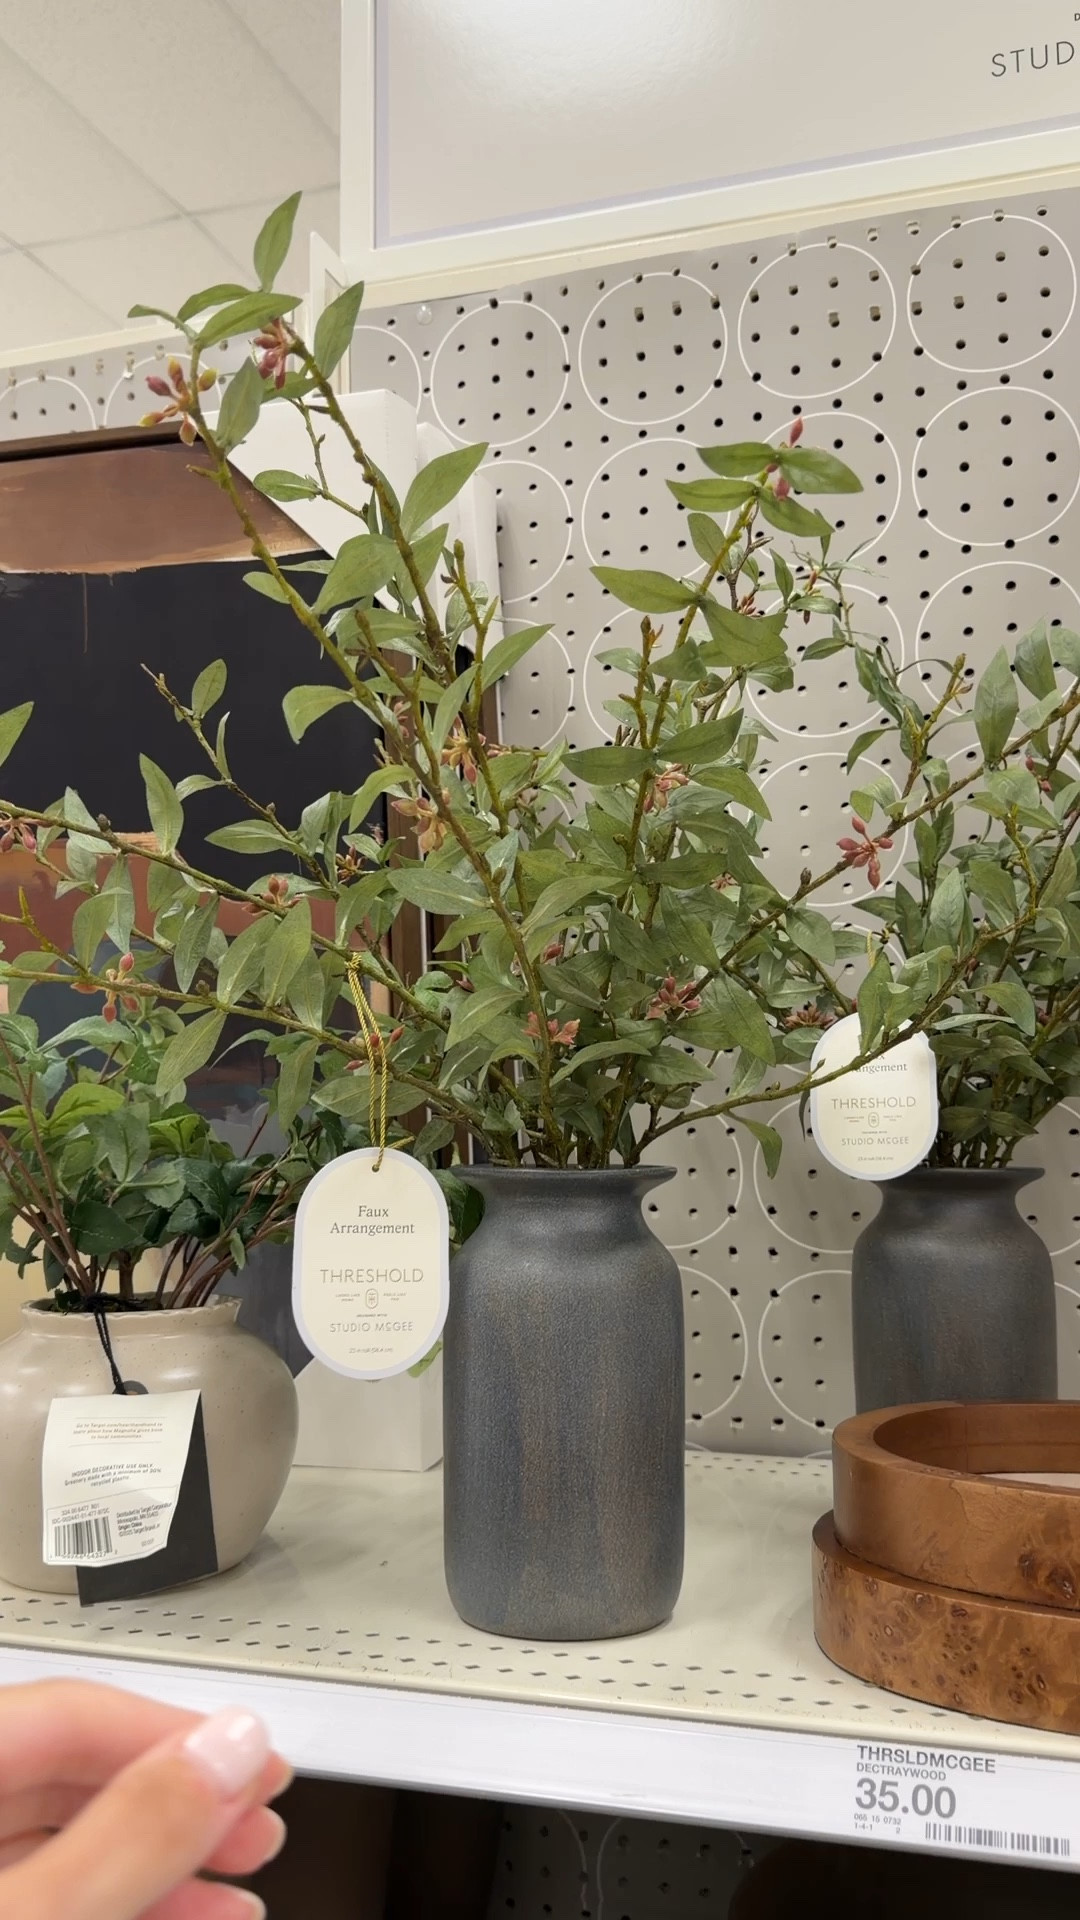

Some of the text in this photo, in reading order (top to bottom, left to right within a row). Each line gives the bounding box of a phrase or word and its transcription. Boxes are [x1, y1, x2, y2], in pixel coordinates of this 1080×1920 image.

[991, 41, 1075, 77] STUD
[831, 1096, 916, 1110] THRESHOLD
[841, 1137, 874, 1146] STUDIO
[358, 1205, 389, 1217] Faux
[330, 1222, 415, 1236] Arrangement
[320, 1268, 424, 1283] THRESHOLD
[330, 1322, 371, 1333] STUDIO
[857, 1745, 996, 1773] THRSLDMCGEE
[856, 1762, 947, 1781] DECTRAYWOOD
[855, 1778, 956, 1818] 35.00
[854, 1822, 873, 1831] 1-4-1
